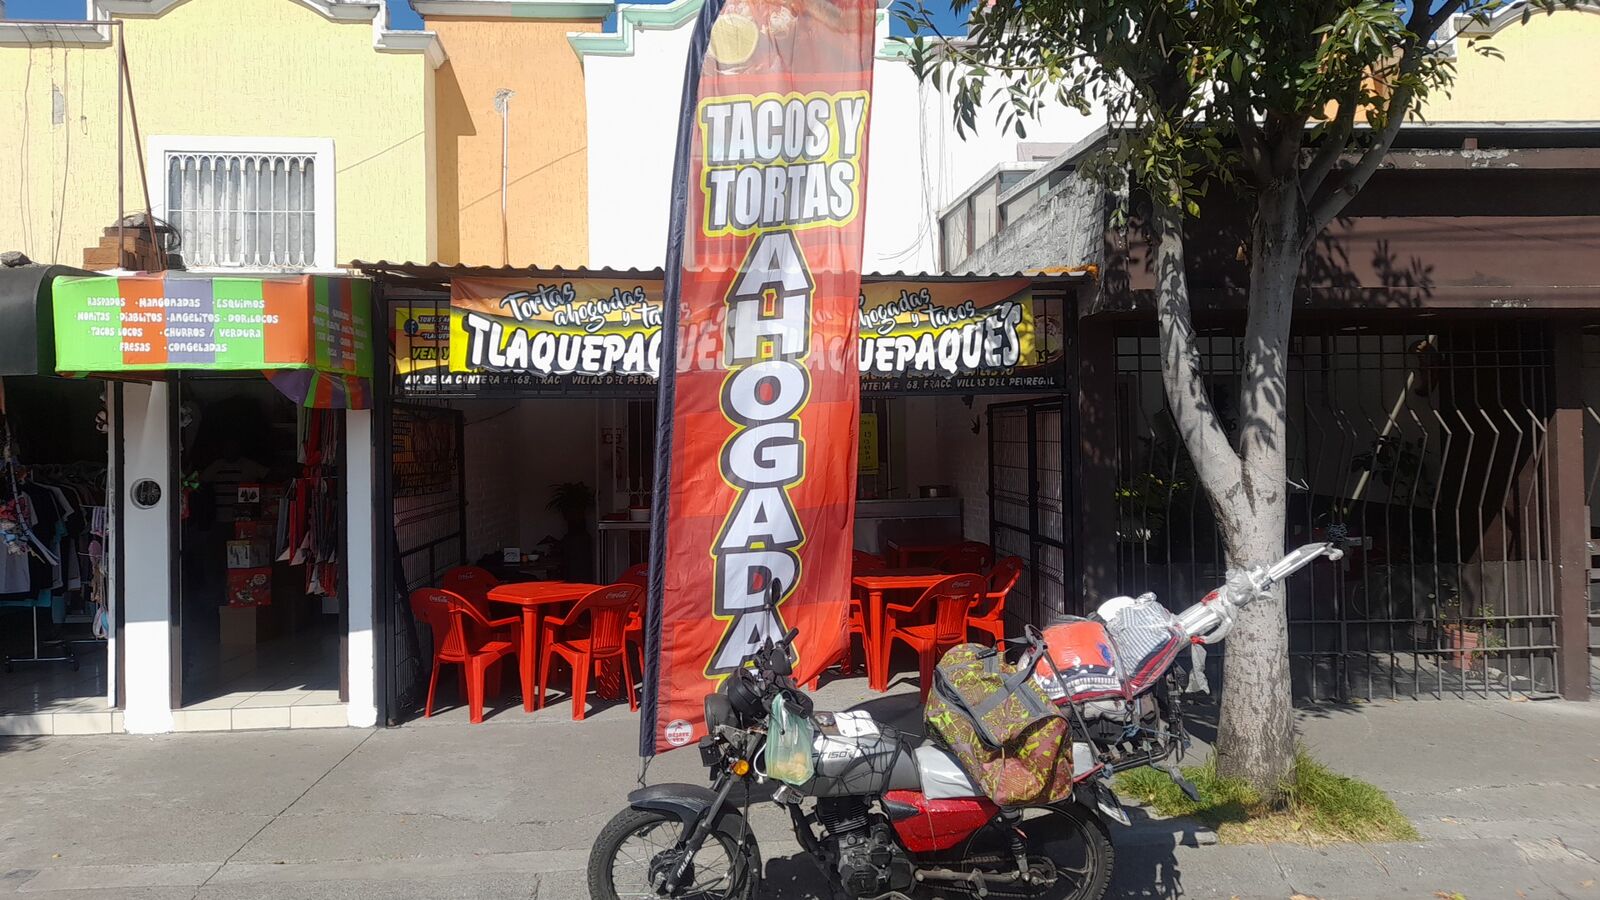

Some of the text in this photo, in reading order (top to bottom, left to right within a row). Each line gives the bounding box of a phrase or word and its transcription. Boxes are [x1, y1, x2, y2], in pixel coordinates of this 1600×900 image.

[703, 97, 866, 164] TACOS Y
[707, 161, 856, 229] TORTAS
[499, 282, 575, 322] Tortas
[554, 286, 646, 333] ahogadas
[910, 300, 976, 329] y tacos
[91, 326, 115, 336] TACOS
[164, 328, 205, 337] CHURROS
[219, 328, 261, 338] VERDURA
[622, 311, 631, 327] y
[119, 342, 151, 352] FRESAS
[412, 347, 437, 359] VEN
[405, 375, 421, 384] AV.
[424, 375, 437, 384] DE
[441, 375, 452, 384] LA
[627, 376, 658, 385] PEDRE
[712, 229, 812, 676] AHOGADA
